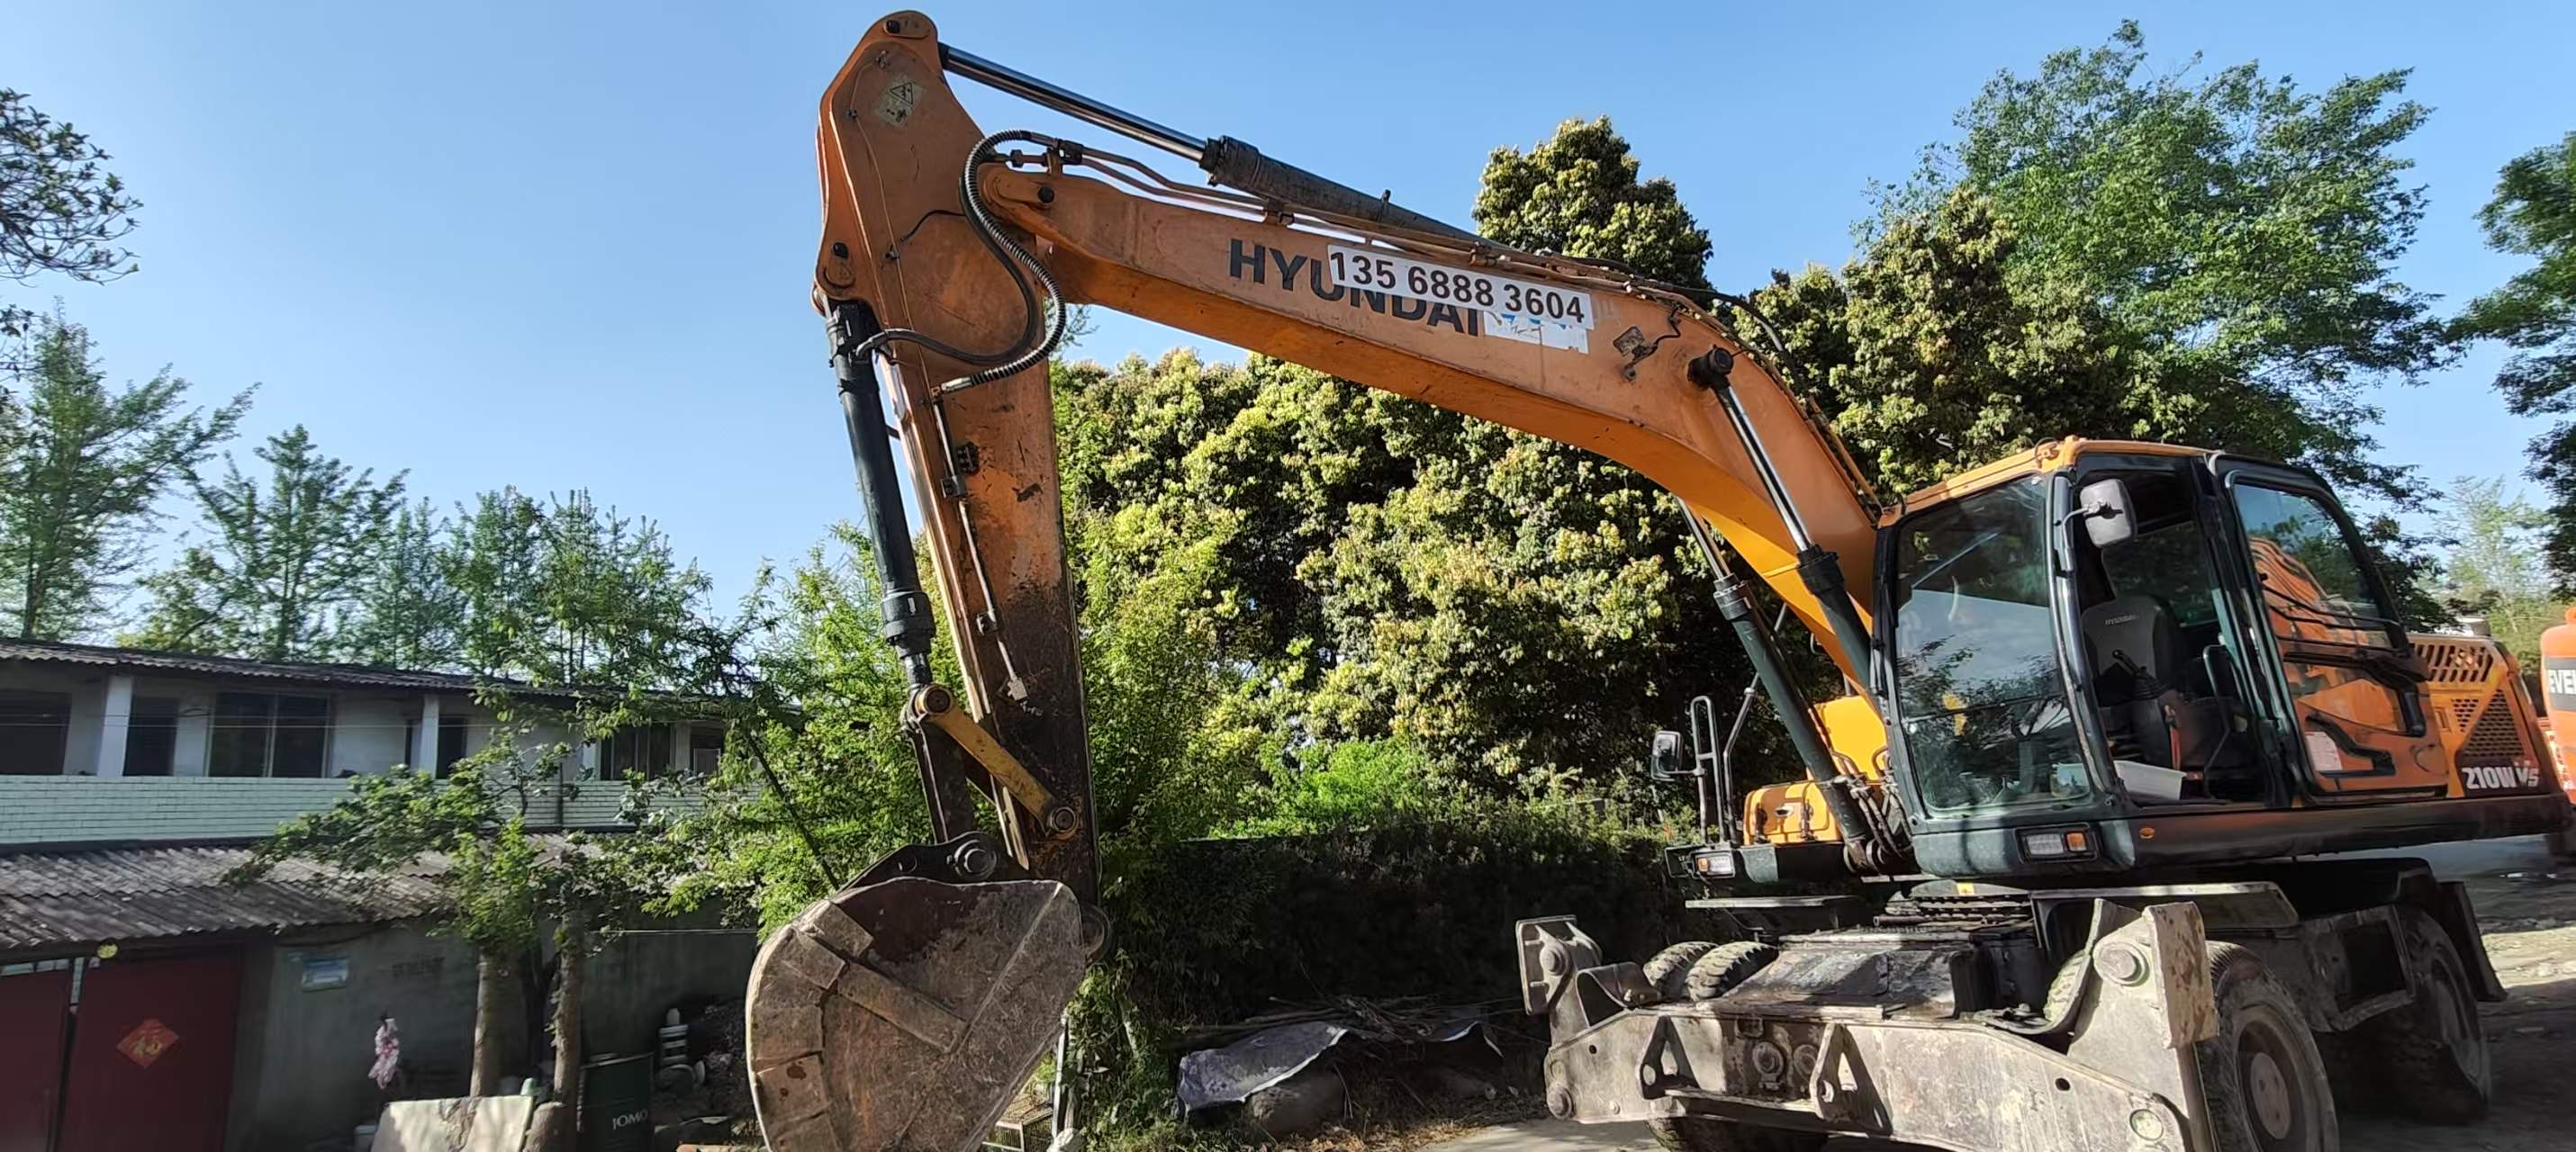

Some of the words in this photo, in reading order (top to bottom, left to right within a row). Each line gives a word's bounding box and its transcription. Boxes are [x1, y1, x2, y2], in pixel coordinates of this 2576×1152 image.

[1331, 252, 1396, 289] 135
[1407, 266, 1495, 307] 6888
[1503, 284, 1585, 324] 3604
